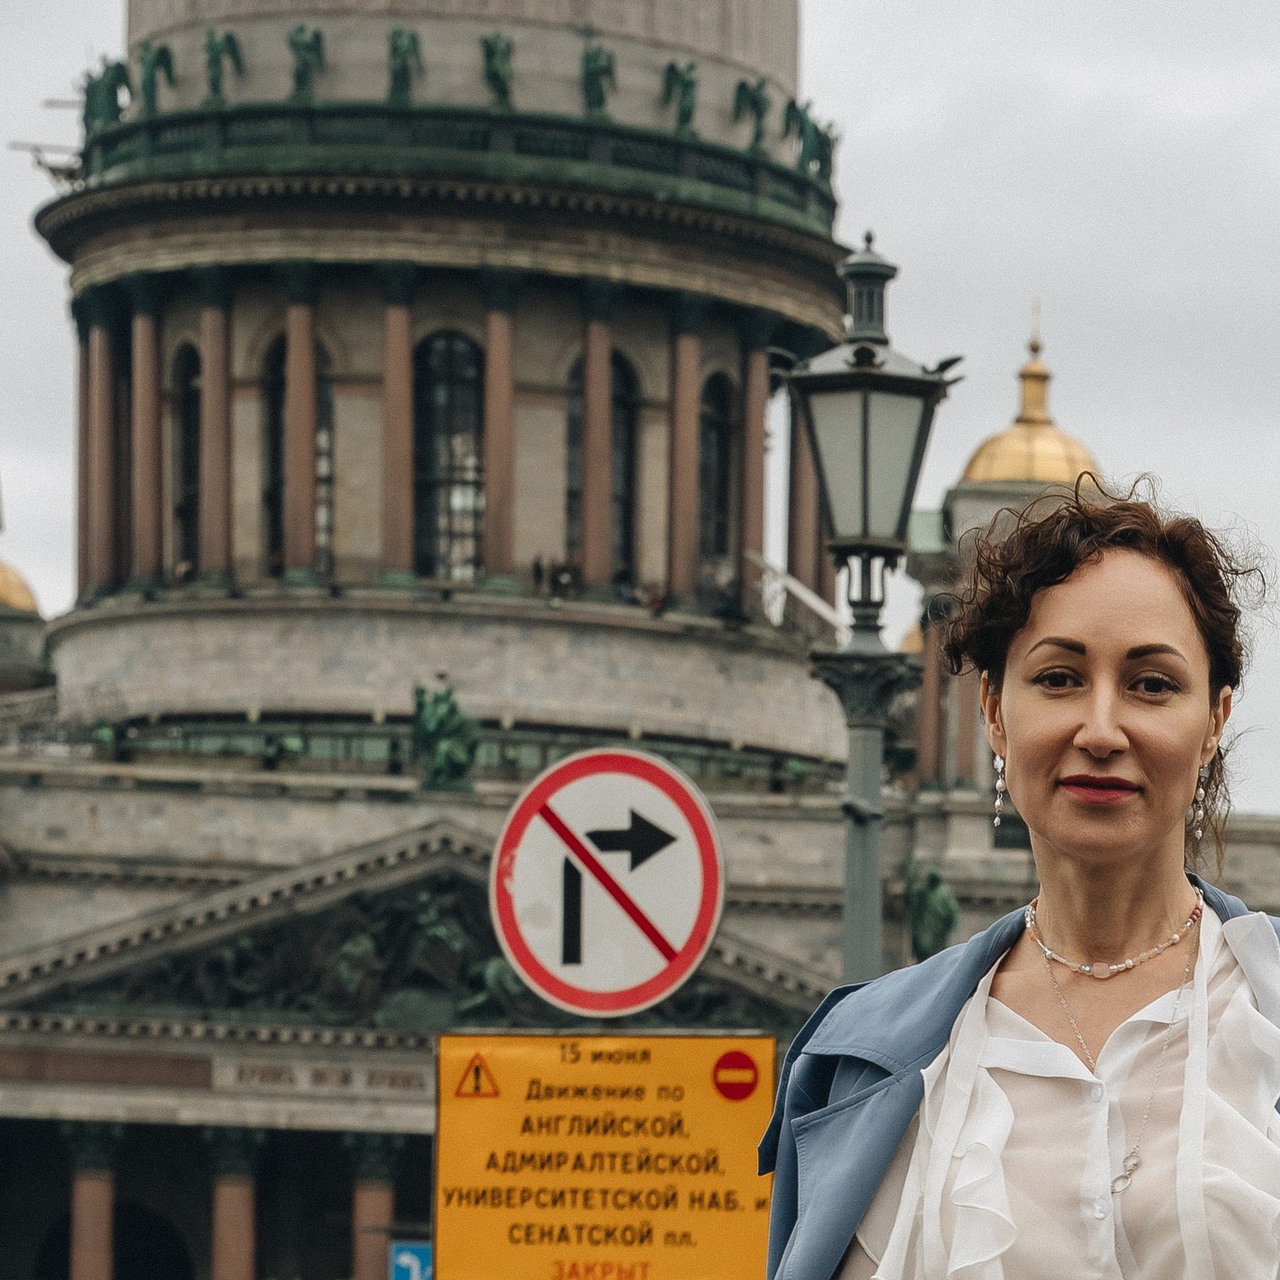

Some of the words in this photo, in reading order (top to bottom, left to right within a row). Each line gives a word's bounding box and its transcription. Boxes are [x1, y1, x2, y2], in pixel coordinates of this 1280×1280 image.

[560, 1042, 581, 1064] 15
[526, 1078, 646, 1101] Движение
[657, 1085, 685, 1101] по
[443, 1185, 678, 1211] УНИВЕРСИТЕТСКОЙ
[508, 1220, 653, 1246] СЕНАТСКОЙ
